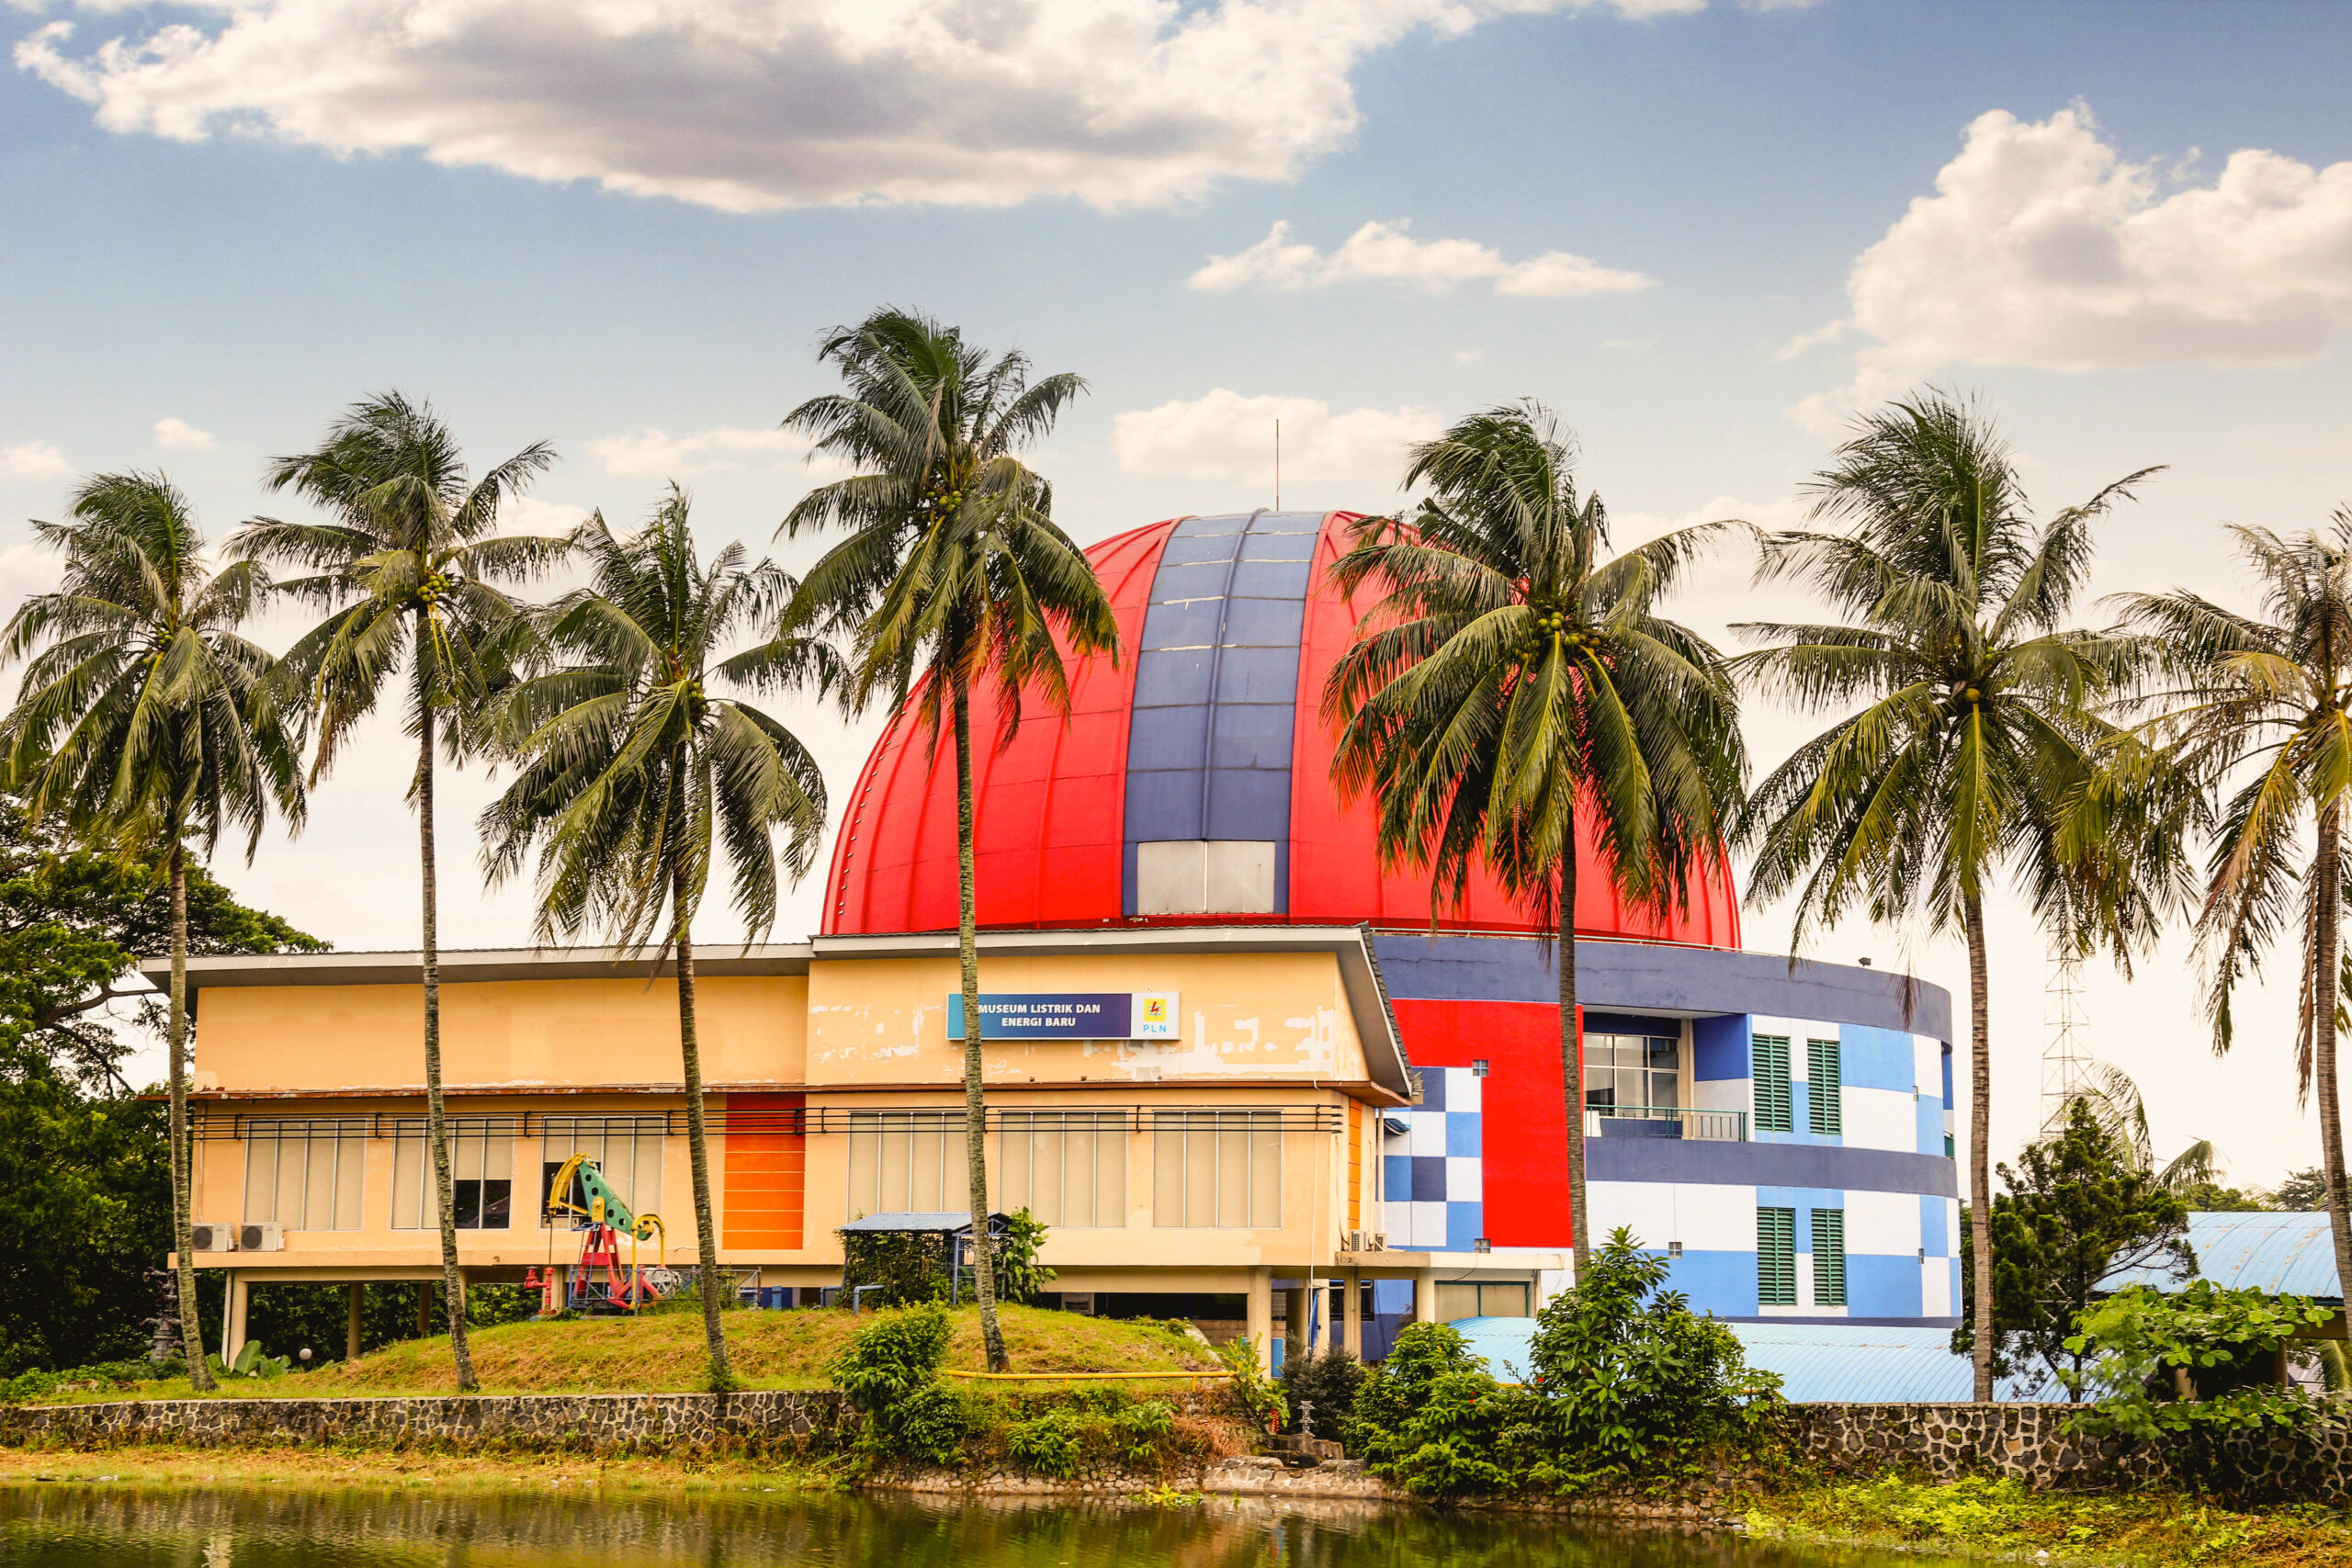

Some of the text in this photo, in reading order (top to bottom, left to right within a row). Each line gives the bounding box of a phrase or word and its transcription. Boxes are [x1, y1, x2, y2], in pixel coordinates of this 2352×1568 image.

[978, 1004, 1101, 1013] MUSEUM LISTRIK DAN
[1001, 1017, 1076, 1027] ENERGI BARU
